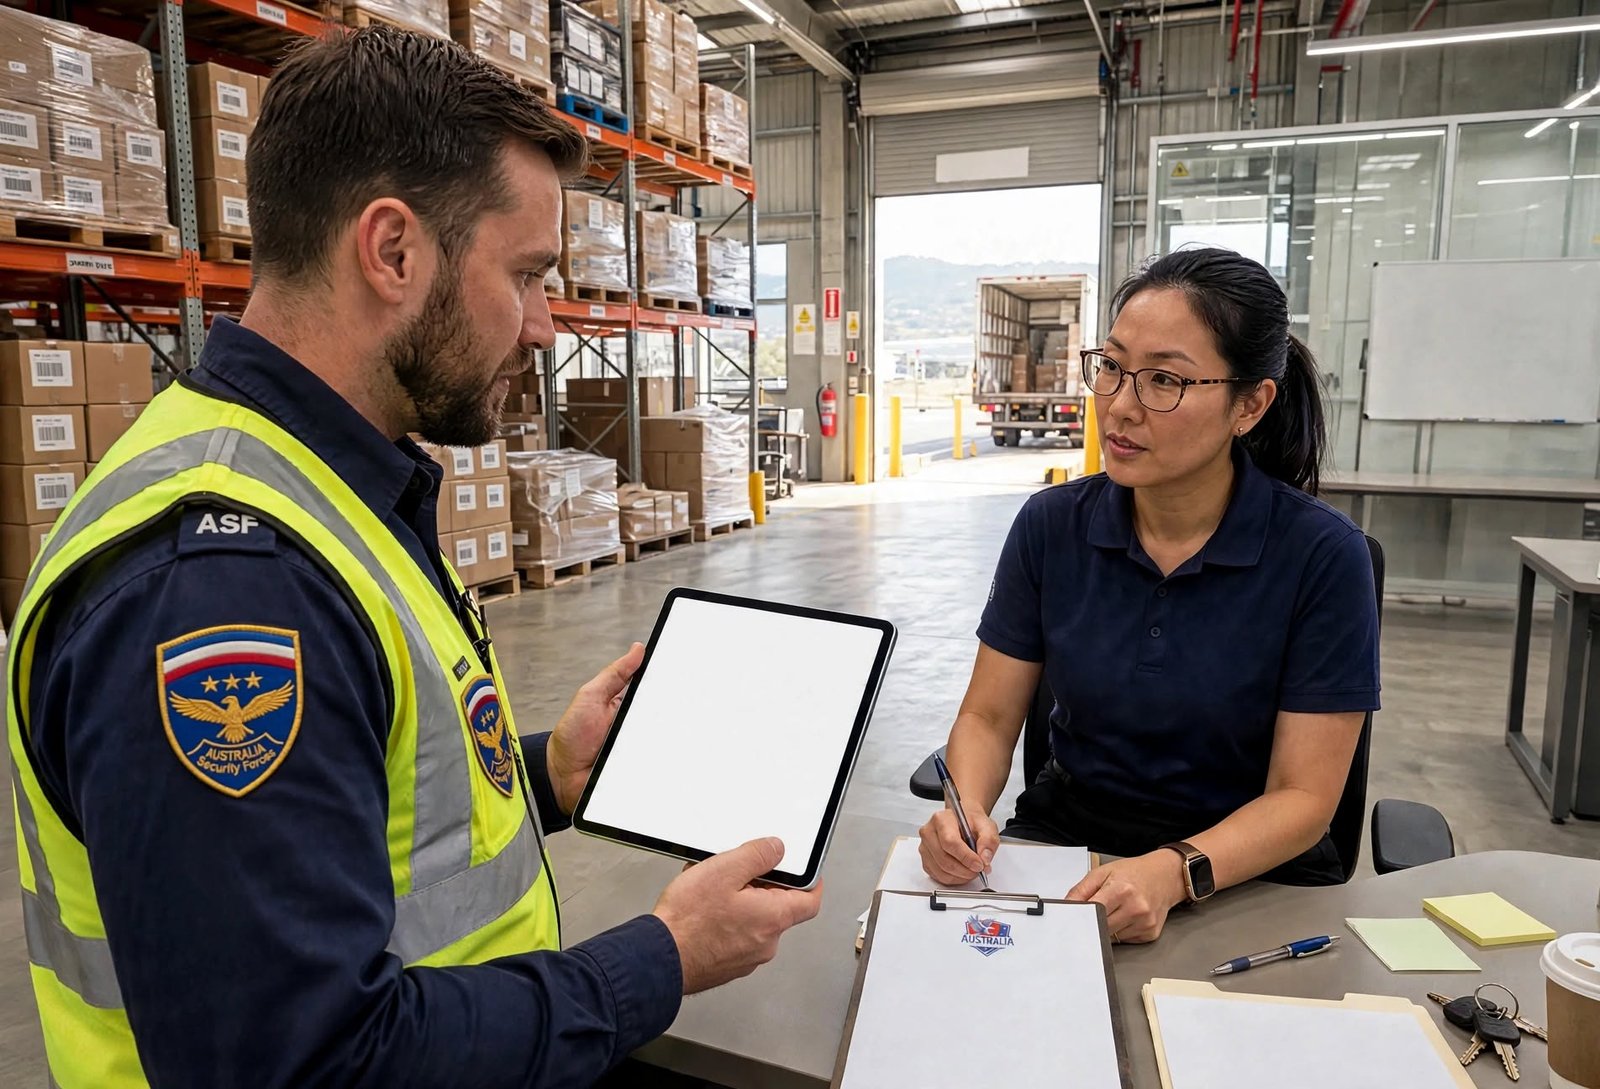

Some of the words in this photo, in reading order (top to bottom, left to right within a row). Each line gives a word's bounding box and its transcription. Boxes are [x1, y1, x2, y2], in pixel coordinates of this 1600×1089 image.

[196, 513, 259, 534] ASF
[205, 743, 267, 761] AUSTRALIA
[197, 755, 240, 776] Security
[961, 934, 1015, 946] AUSTRALIA
